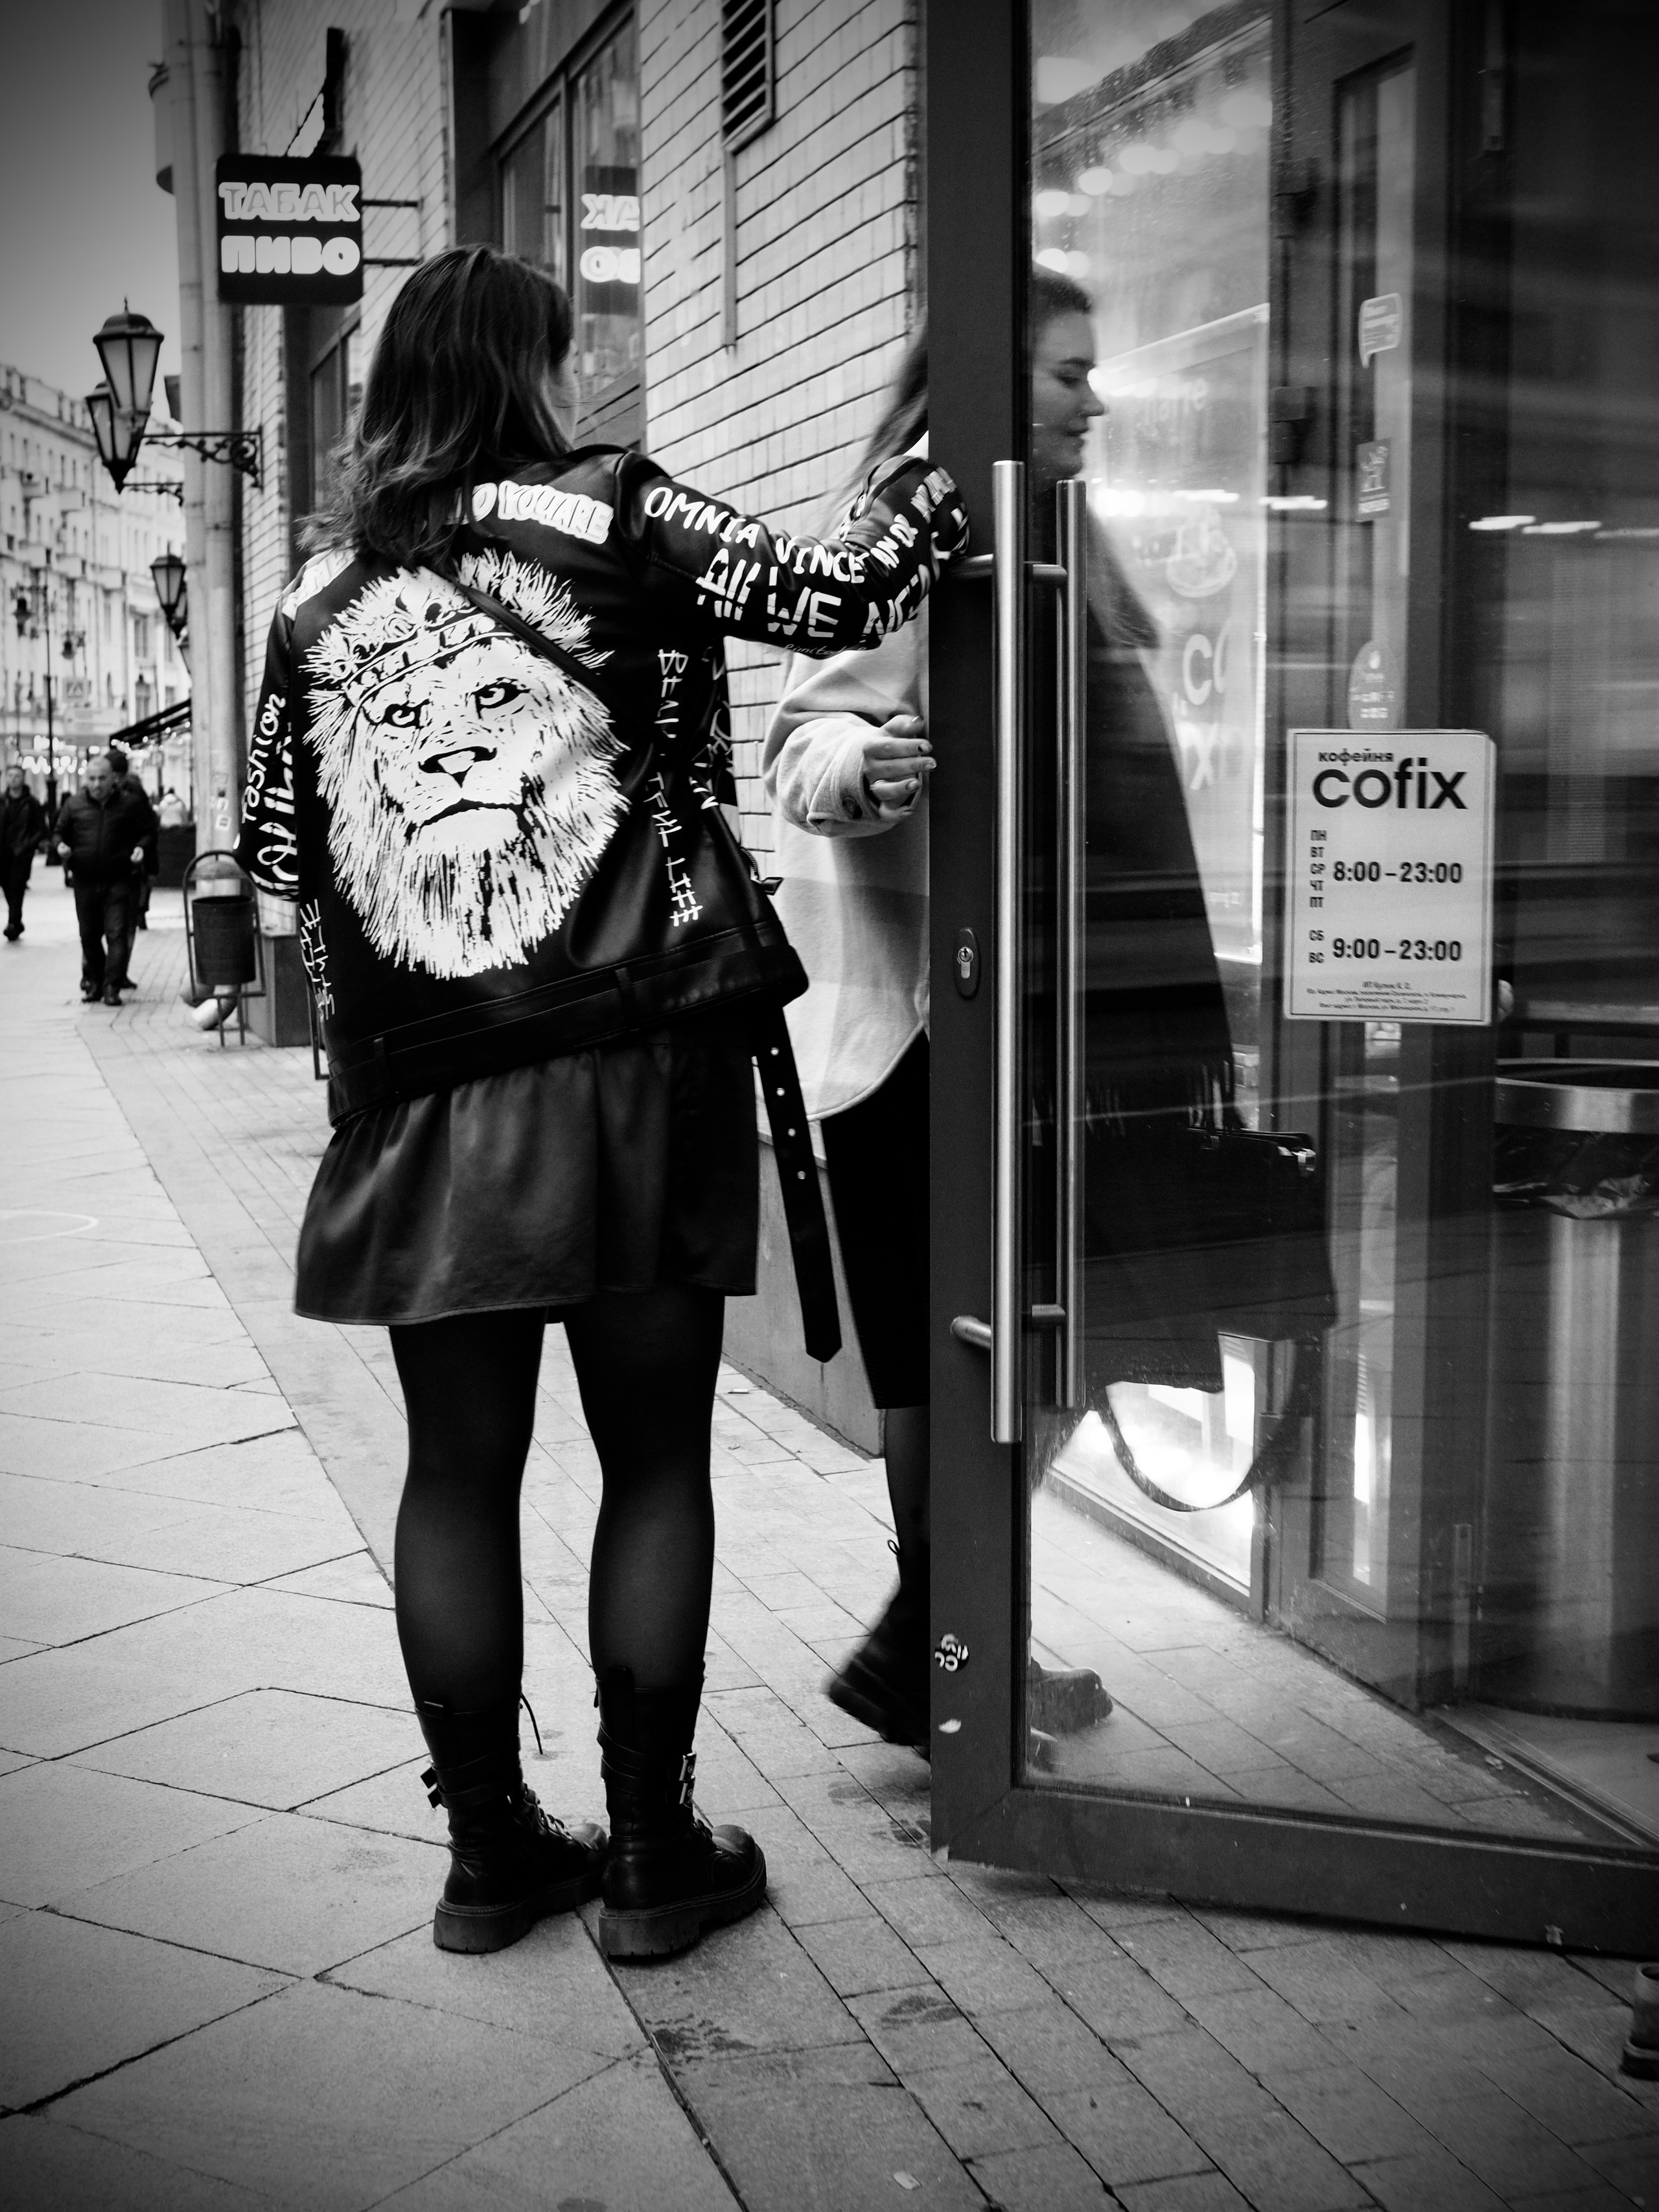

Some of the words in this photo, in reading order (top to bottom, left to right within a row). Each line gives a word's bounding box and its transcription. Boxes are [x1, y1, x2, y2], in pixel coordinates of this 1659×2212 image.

[218, 181, 360, 221] ТАБАК
[221, 235, 361, 275] ПИВО
[644, 487, 761, 548] OMNIA
[1318, 749, 1395, 766] кофейня
[1313, 757, 1468, 809] cofix
